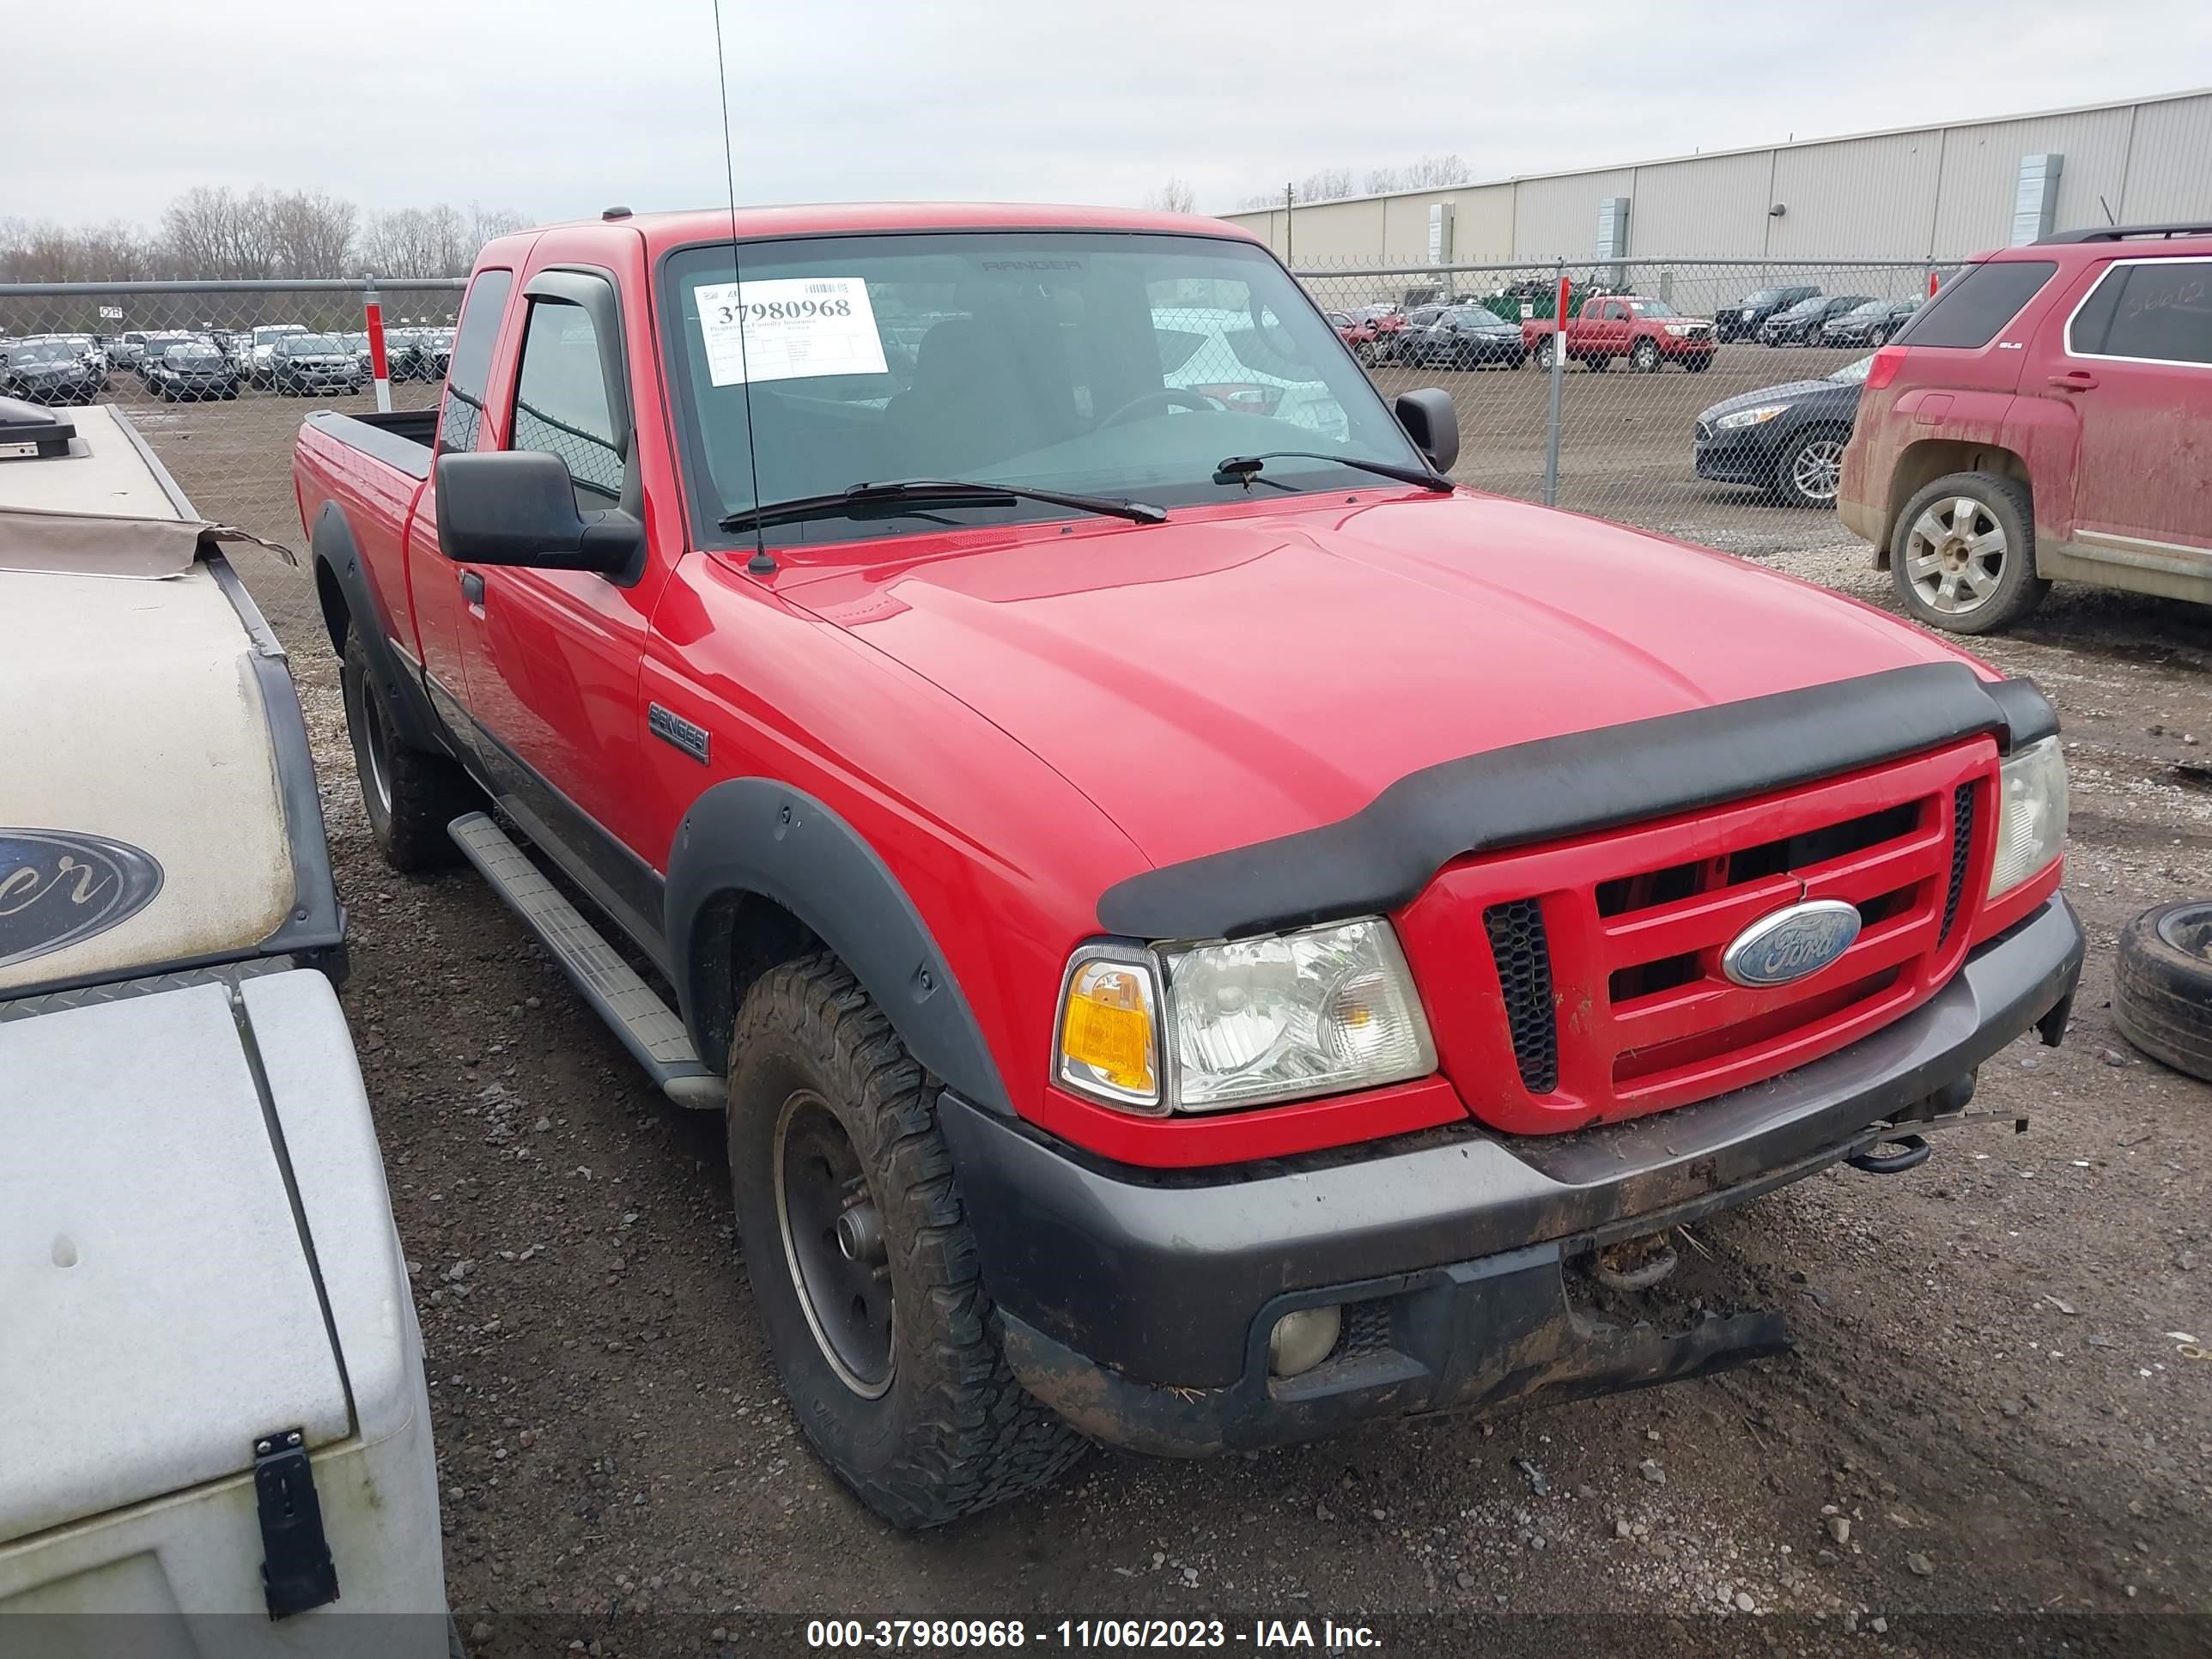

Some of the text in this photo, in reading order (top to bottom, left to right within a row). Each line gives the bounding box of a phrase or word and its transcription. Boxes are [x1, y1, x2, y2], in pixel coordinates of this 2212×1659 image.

[981, 260, 1084, 271] RANGER
[718, 298, 852, 325] 37980968
[650, 706, 706, 753] RANGER
[1765, 920, 1838, 975] Ford
